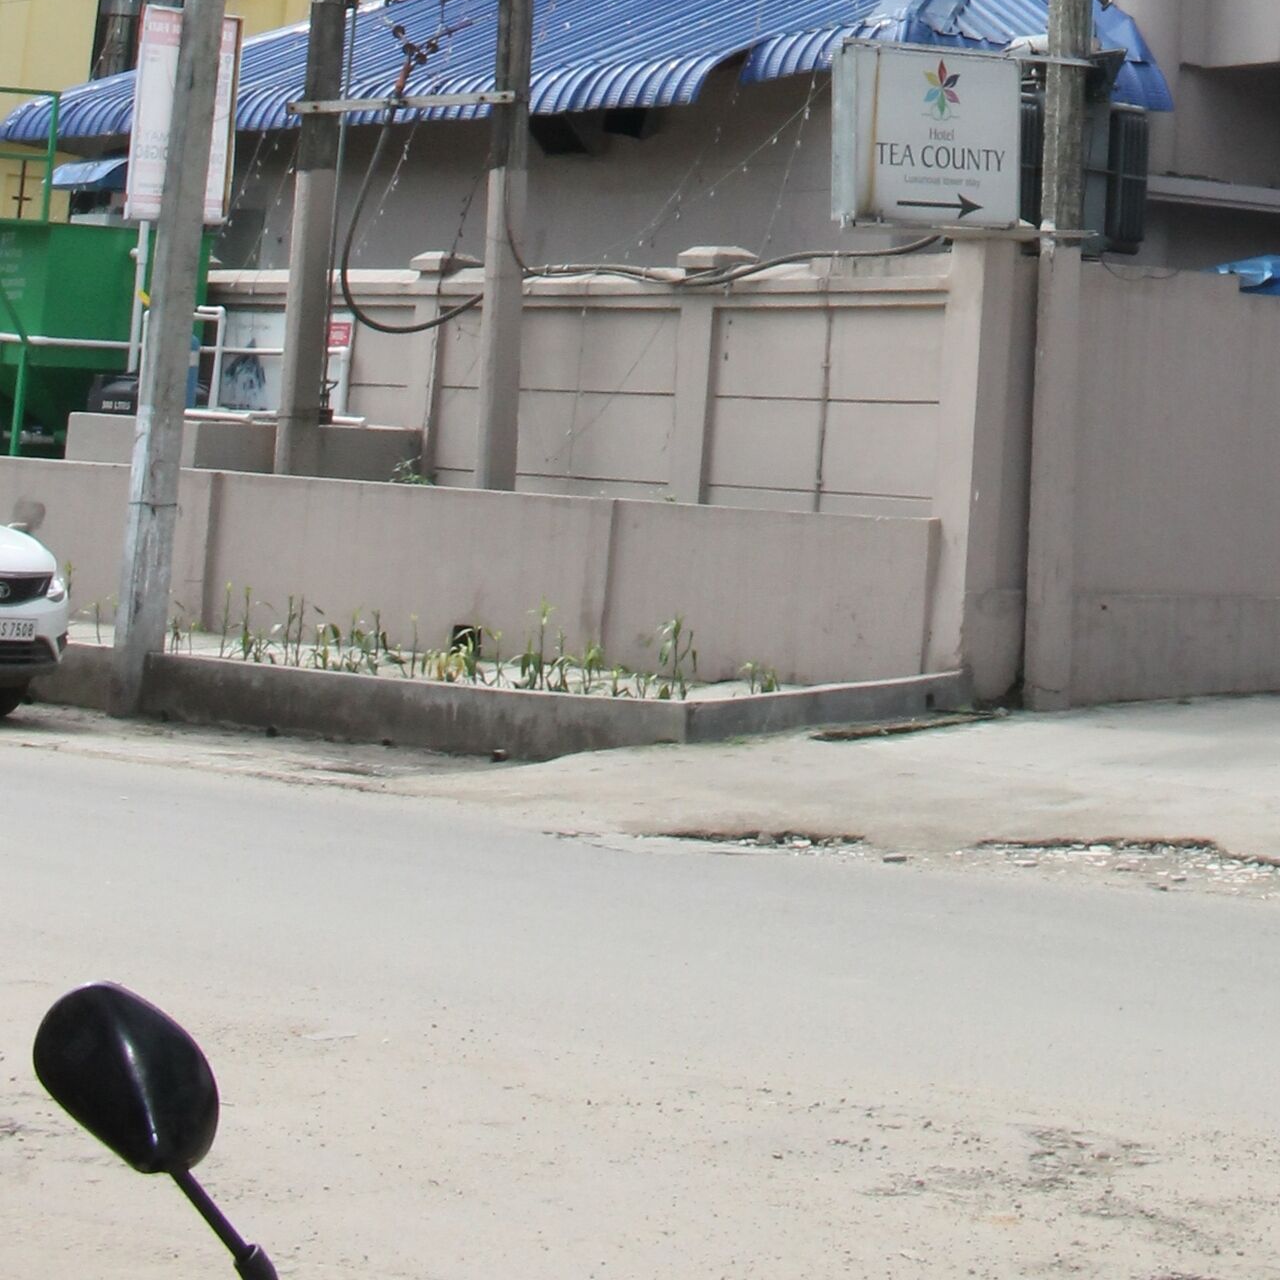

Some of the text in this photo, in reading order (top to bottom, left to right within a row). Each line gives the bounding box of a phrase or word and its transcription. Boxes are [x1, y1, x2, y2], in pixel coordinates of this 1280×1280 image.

[928, 127, 955, 142] Hotel
[876, 142, 1006, 172] TEA COUNTY
